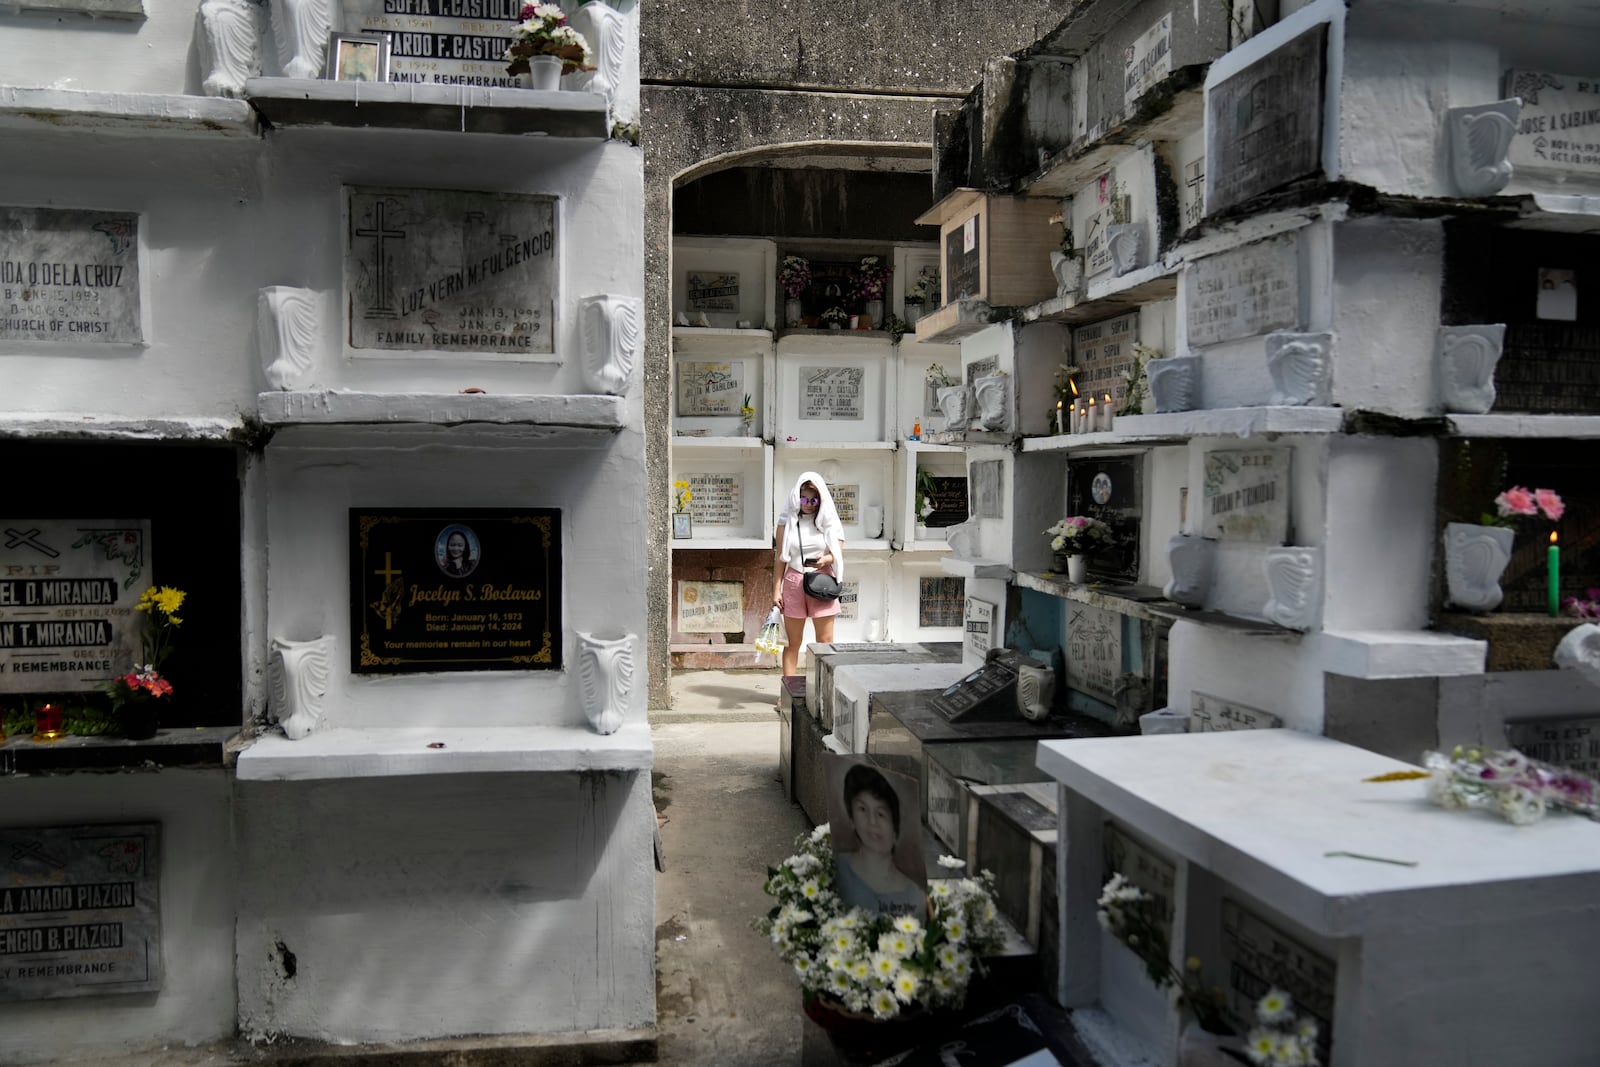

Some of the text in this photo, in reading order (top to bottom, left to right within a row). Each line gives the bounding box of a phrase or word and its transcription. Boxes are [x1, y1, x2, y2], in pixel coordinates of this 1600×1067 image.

[434, 77, 522, 88] REMEMBRANCE
[84, 264, 124, 288] CRUZ
[401, 287, 426, 318] LUZ
[429, 269, 465, 304] VERN
[50, 321, 65, 333] OF
[69, 321, 110, 333] CHRIST
[377, 332, 532, 349] FAMILY REMEMBRANCE
[42, 580, 112, 605] MIRANDA
[409, 584, 461, 607] Jocelyn
[463, 583, 476, 601] S.
[425, 614, 449, 622] Born:
[451, 614, 486, 623] January
[503, 613, 523, 621] 1973
[36, 622, 108, 646] MIRANDA
[425, 623, 448, 631] Died:
[451, 623, 486, 632] January
[502, 623, 522, 631] 2024
[384, 641, 404, 649] Your
[406, 641, 448, 649] memories
[481, 640, 491, 648] in
[509, 640, 531, 648] heart
[13, 660, 111, 672] REMEMBRANCE
[20, 887, 73, 911] AMADO
[77, 884, 132, 909] PIAZON
[63, 924, 121, 950] PIAZON
[18, 962, 117, 978] REMEMBRANCE
